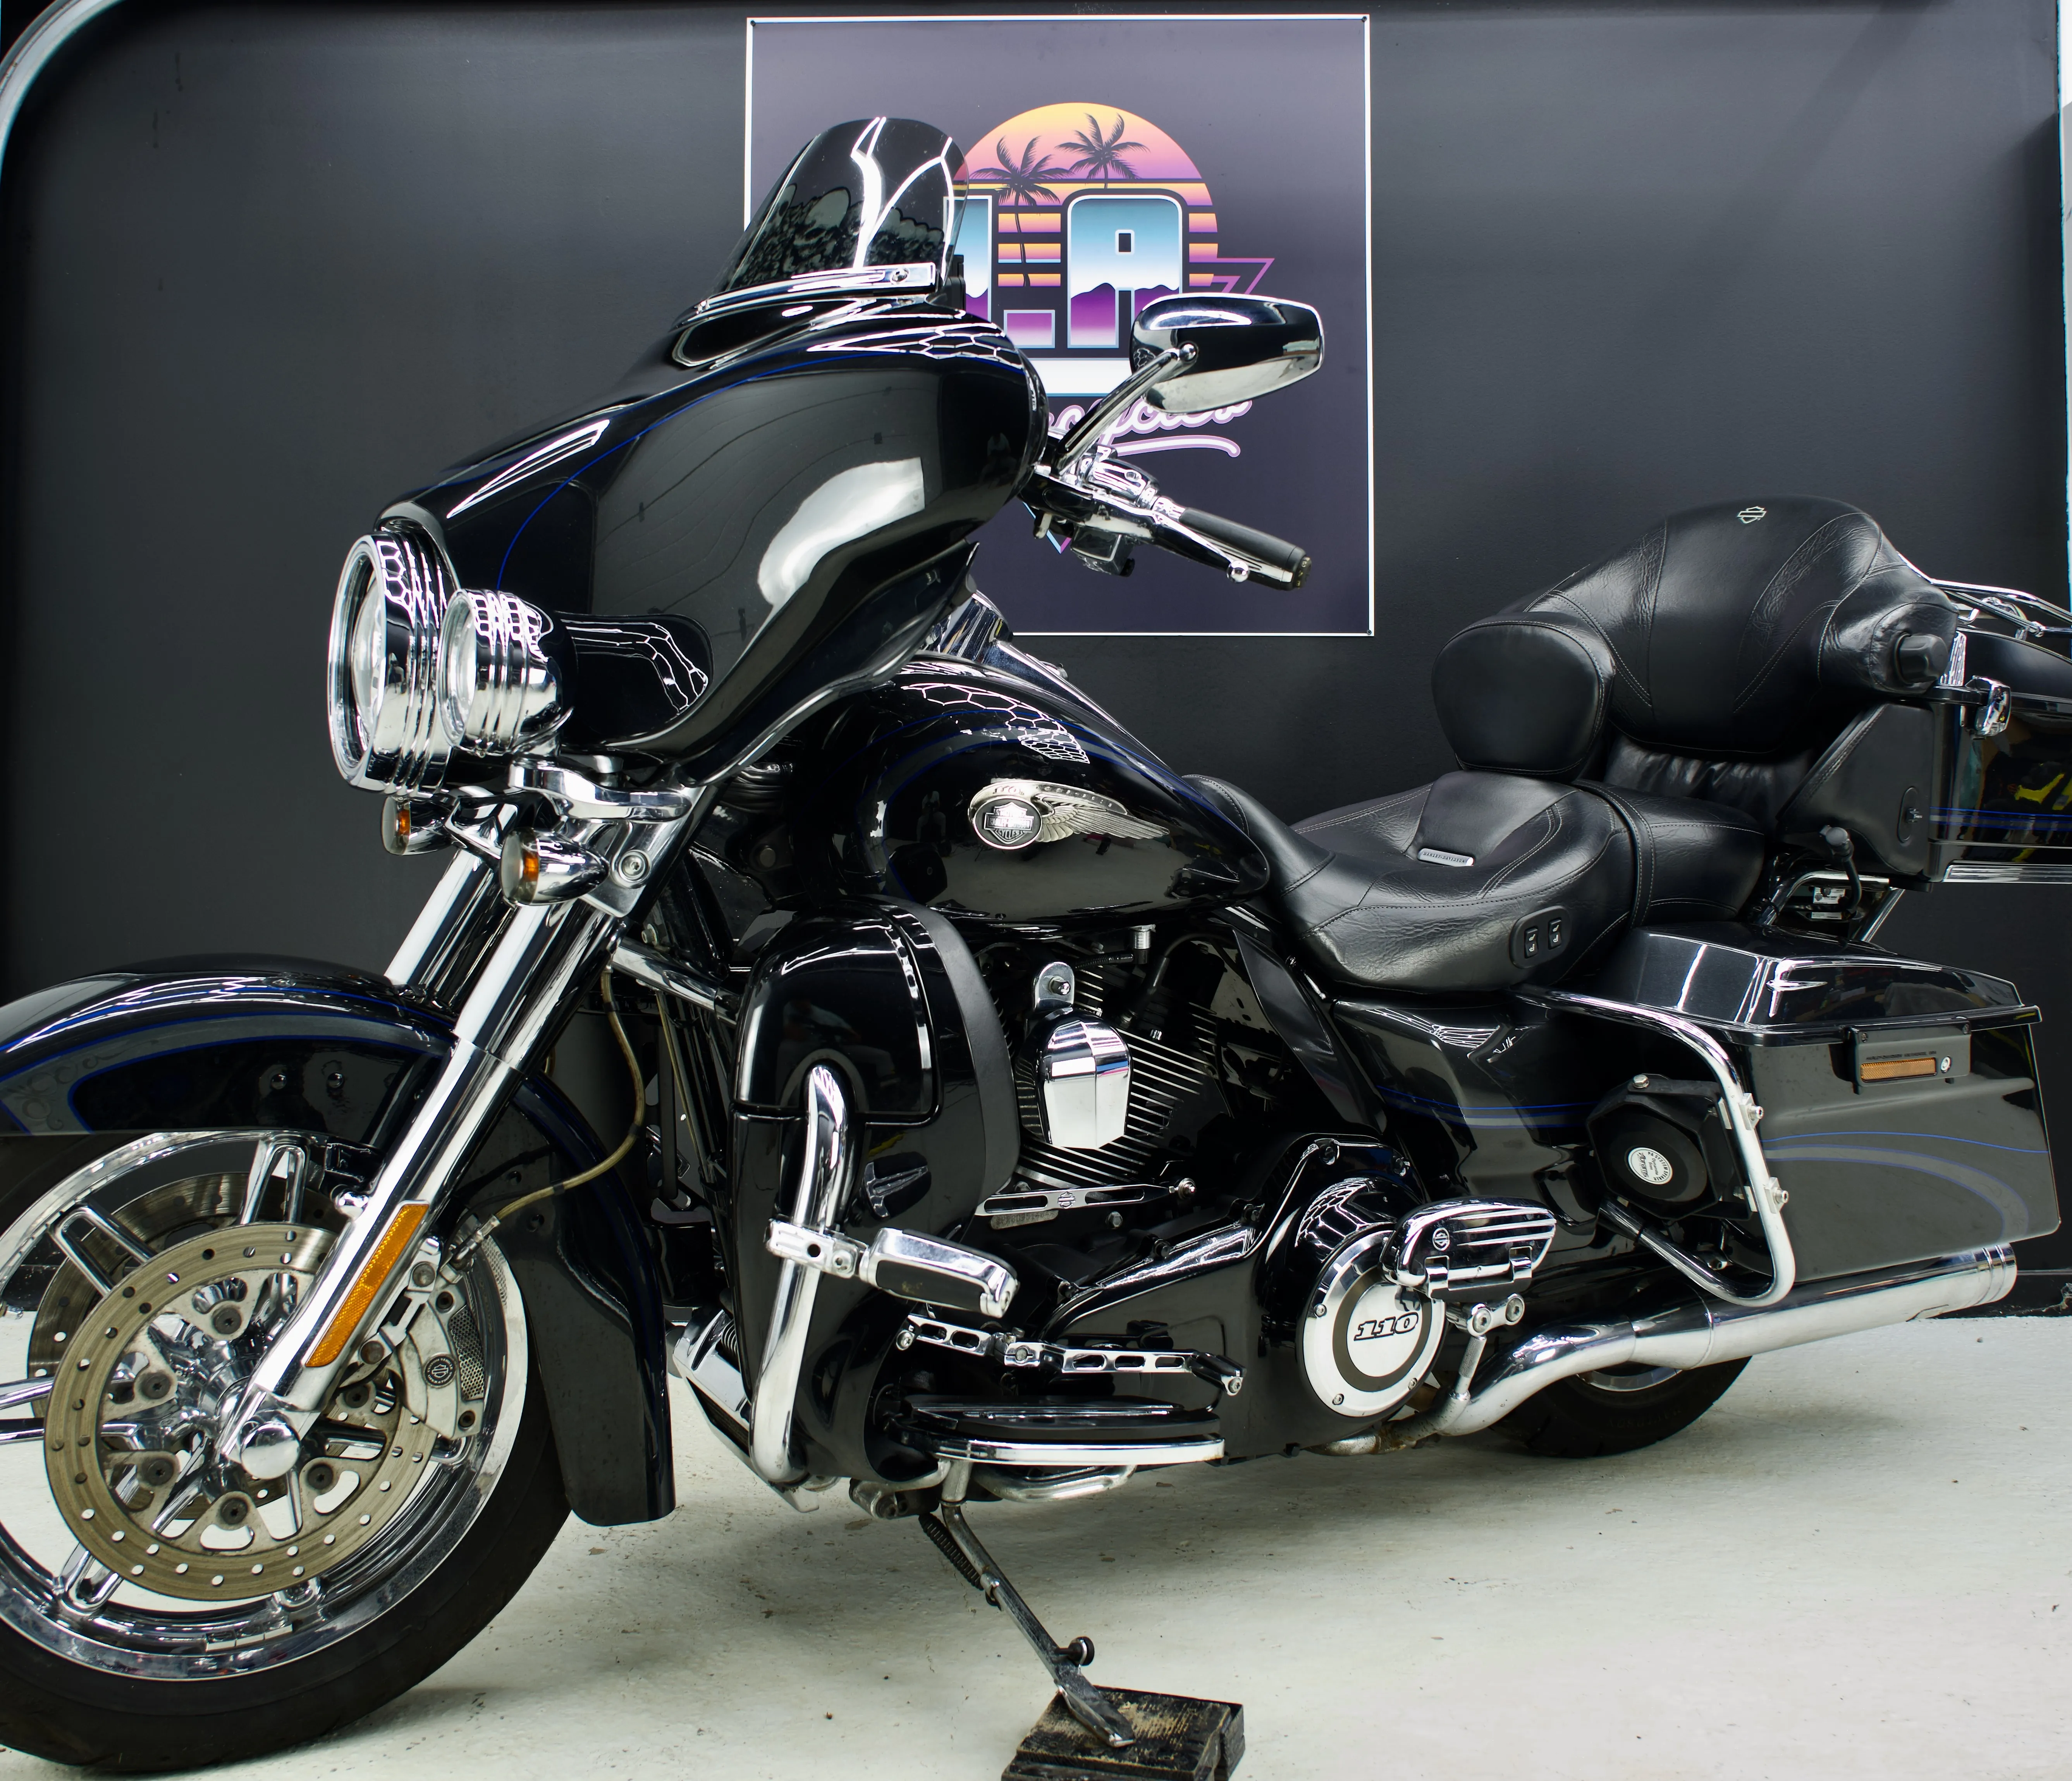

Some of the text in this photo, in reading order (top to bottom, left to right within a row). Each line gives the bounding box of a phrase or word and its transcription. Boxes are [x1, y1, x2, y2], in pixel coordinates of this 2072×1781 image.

[989, 817, 1030, 828] HARLEY-VIDSON
[998, 828, 1020, 840] CYCLES
[1423, 852, 1465, 863] HARLEY-DAVIDSON
[1639, 1153, 1649, 1178] Abrams
[1654, 1155, 1668, 1170] SYSTEM
[1653, 1171, 1668, 1181] SPEAKER
[1353, 1312, 1419, 1341] 110
